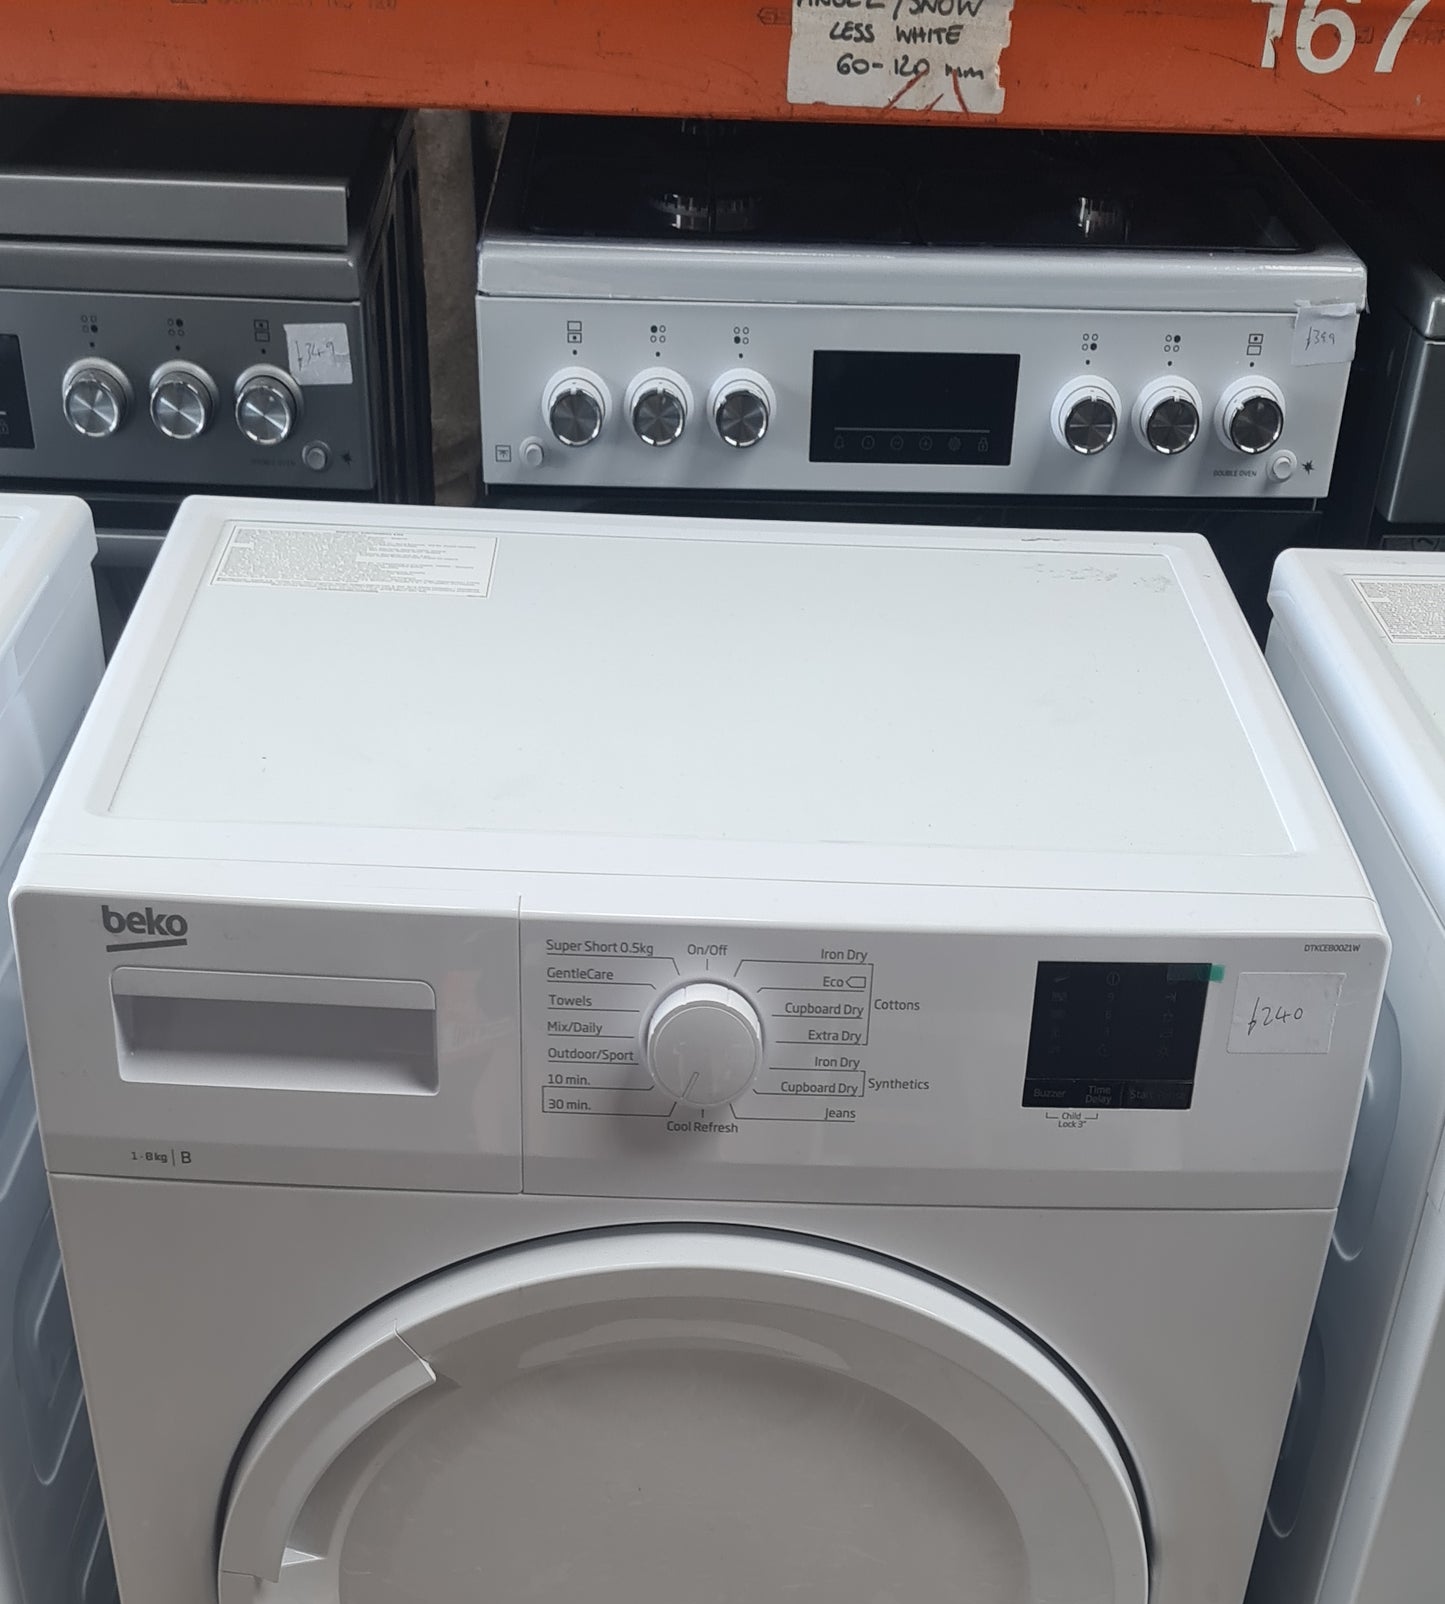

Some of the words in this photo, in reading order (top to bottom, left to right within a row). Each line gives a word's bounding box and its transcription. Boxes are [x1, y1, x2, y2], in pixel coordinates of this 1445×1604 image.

[829, 21, 875, 43] LESS
[896, 24, 964, 45] WHITE
[1253, 0, 1430, 74] 167
[101, 905, 188, 936] beko
[546, 939, 582, 953] Super
[585, 941, 617, 953] Short
[620, 942, 654, 956] 0.5kg
[687, 943, 728, 956] On/Off
[821, 949, 844, 960] Iron
[847, 949, 868, 964] Dry
[547, 967, 614, 980] GentleCare
[823, 976, 844, 987] Eco
[549, 994, 592, 1007] Towels
[874, 999, 920, 1011] Cottons
[785, 1002, 841, 1016] Cupboard
[844, 1004, 864, 1018] Dry
[547, 1021, 603, 1036] Mix/Daily
[808, 1029, 839, 1041] Extra
[842, 1031, 862, 1045] Dry
[548, 1047, 634, 1062] Outdoor/Sport
[814, 1056, 837, 1067] Iron
[840, 1057, 860, 1071] Dry
[548, 1074, 563, 1085] 10
[565, 1075, 590, 1086] min.
[868, 1078, 929, 1091] Synthetics
[781, 1081, 836, 1095] Cupboard
[838, 1083, 858, 1096] Dry
[1033, 1088, 1066, 1098] Buzzer
[1089, 1085, 1111, 1094] Time
[548, 1099, 564, 1110] 30
[567, 1100, 591, 1110] min.
[1085, 1094, 1112, 1104] Delay
[824, 1107, 856, 1120] Jeans
[1062, 1112, 1081, 1120] Child
[667, 1121, 691, 1132] Cool
[694, 1121, 738, 1133] Refresh
[1058, 1120, 1076, 1128] Lock
[181, 1151, 192, 1164] B
